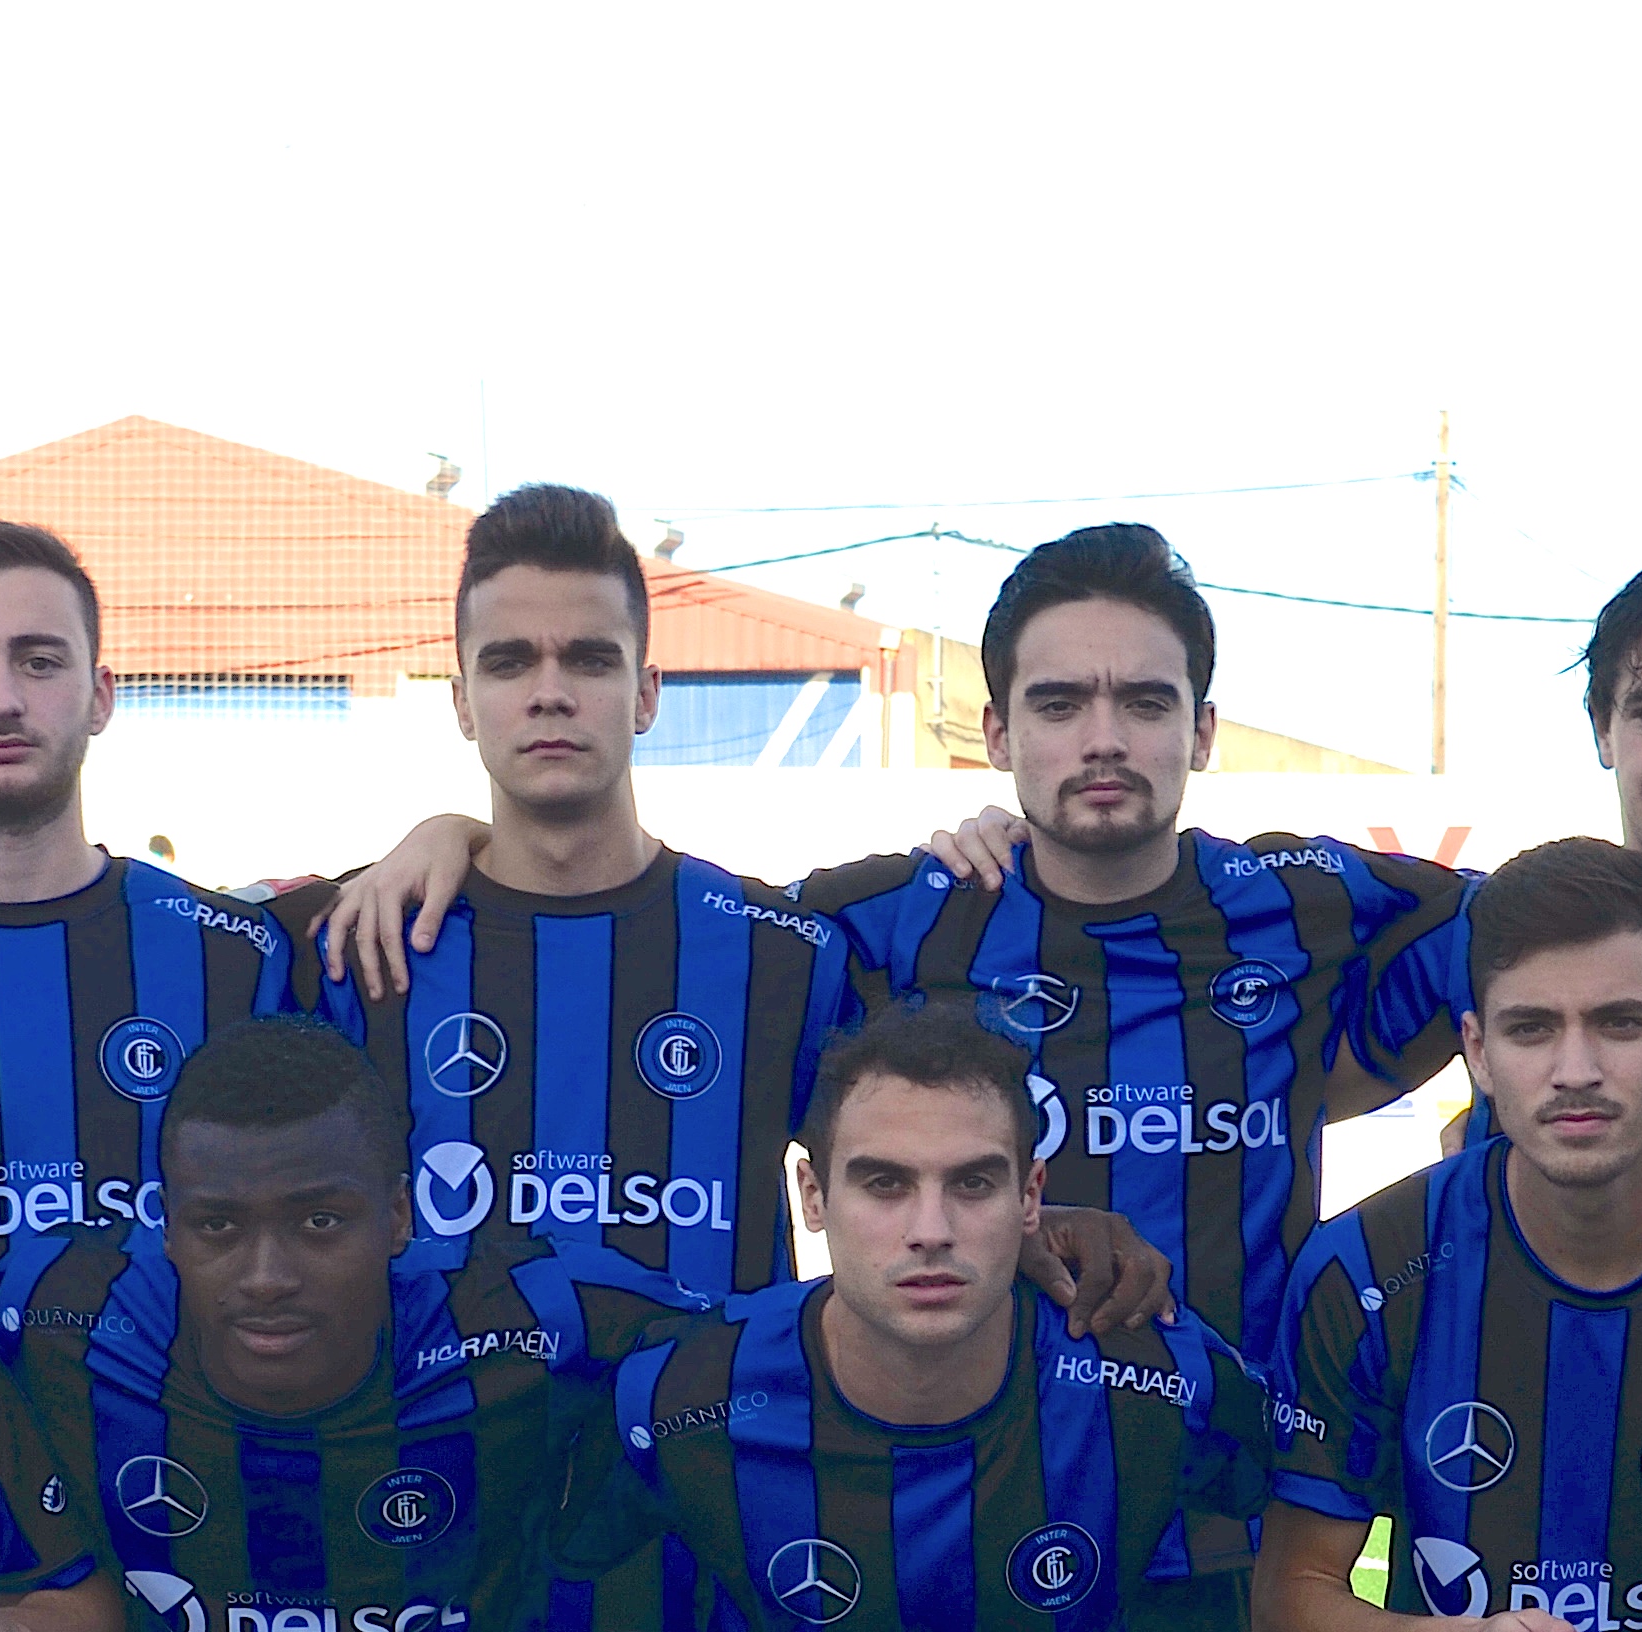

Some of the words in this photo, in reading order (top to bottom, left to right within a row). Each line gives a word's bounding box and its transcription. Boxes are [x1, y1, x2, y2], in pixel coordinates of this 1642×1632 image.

[1086, 1083, 1194, 1103] software
[513, 1151, 613, 1173] software
[1511, 1558, 1613, 1583] software
